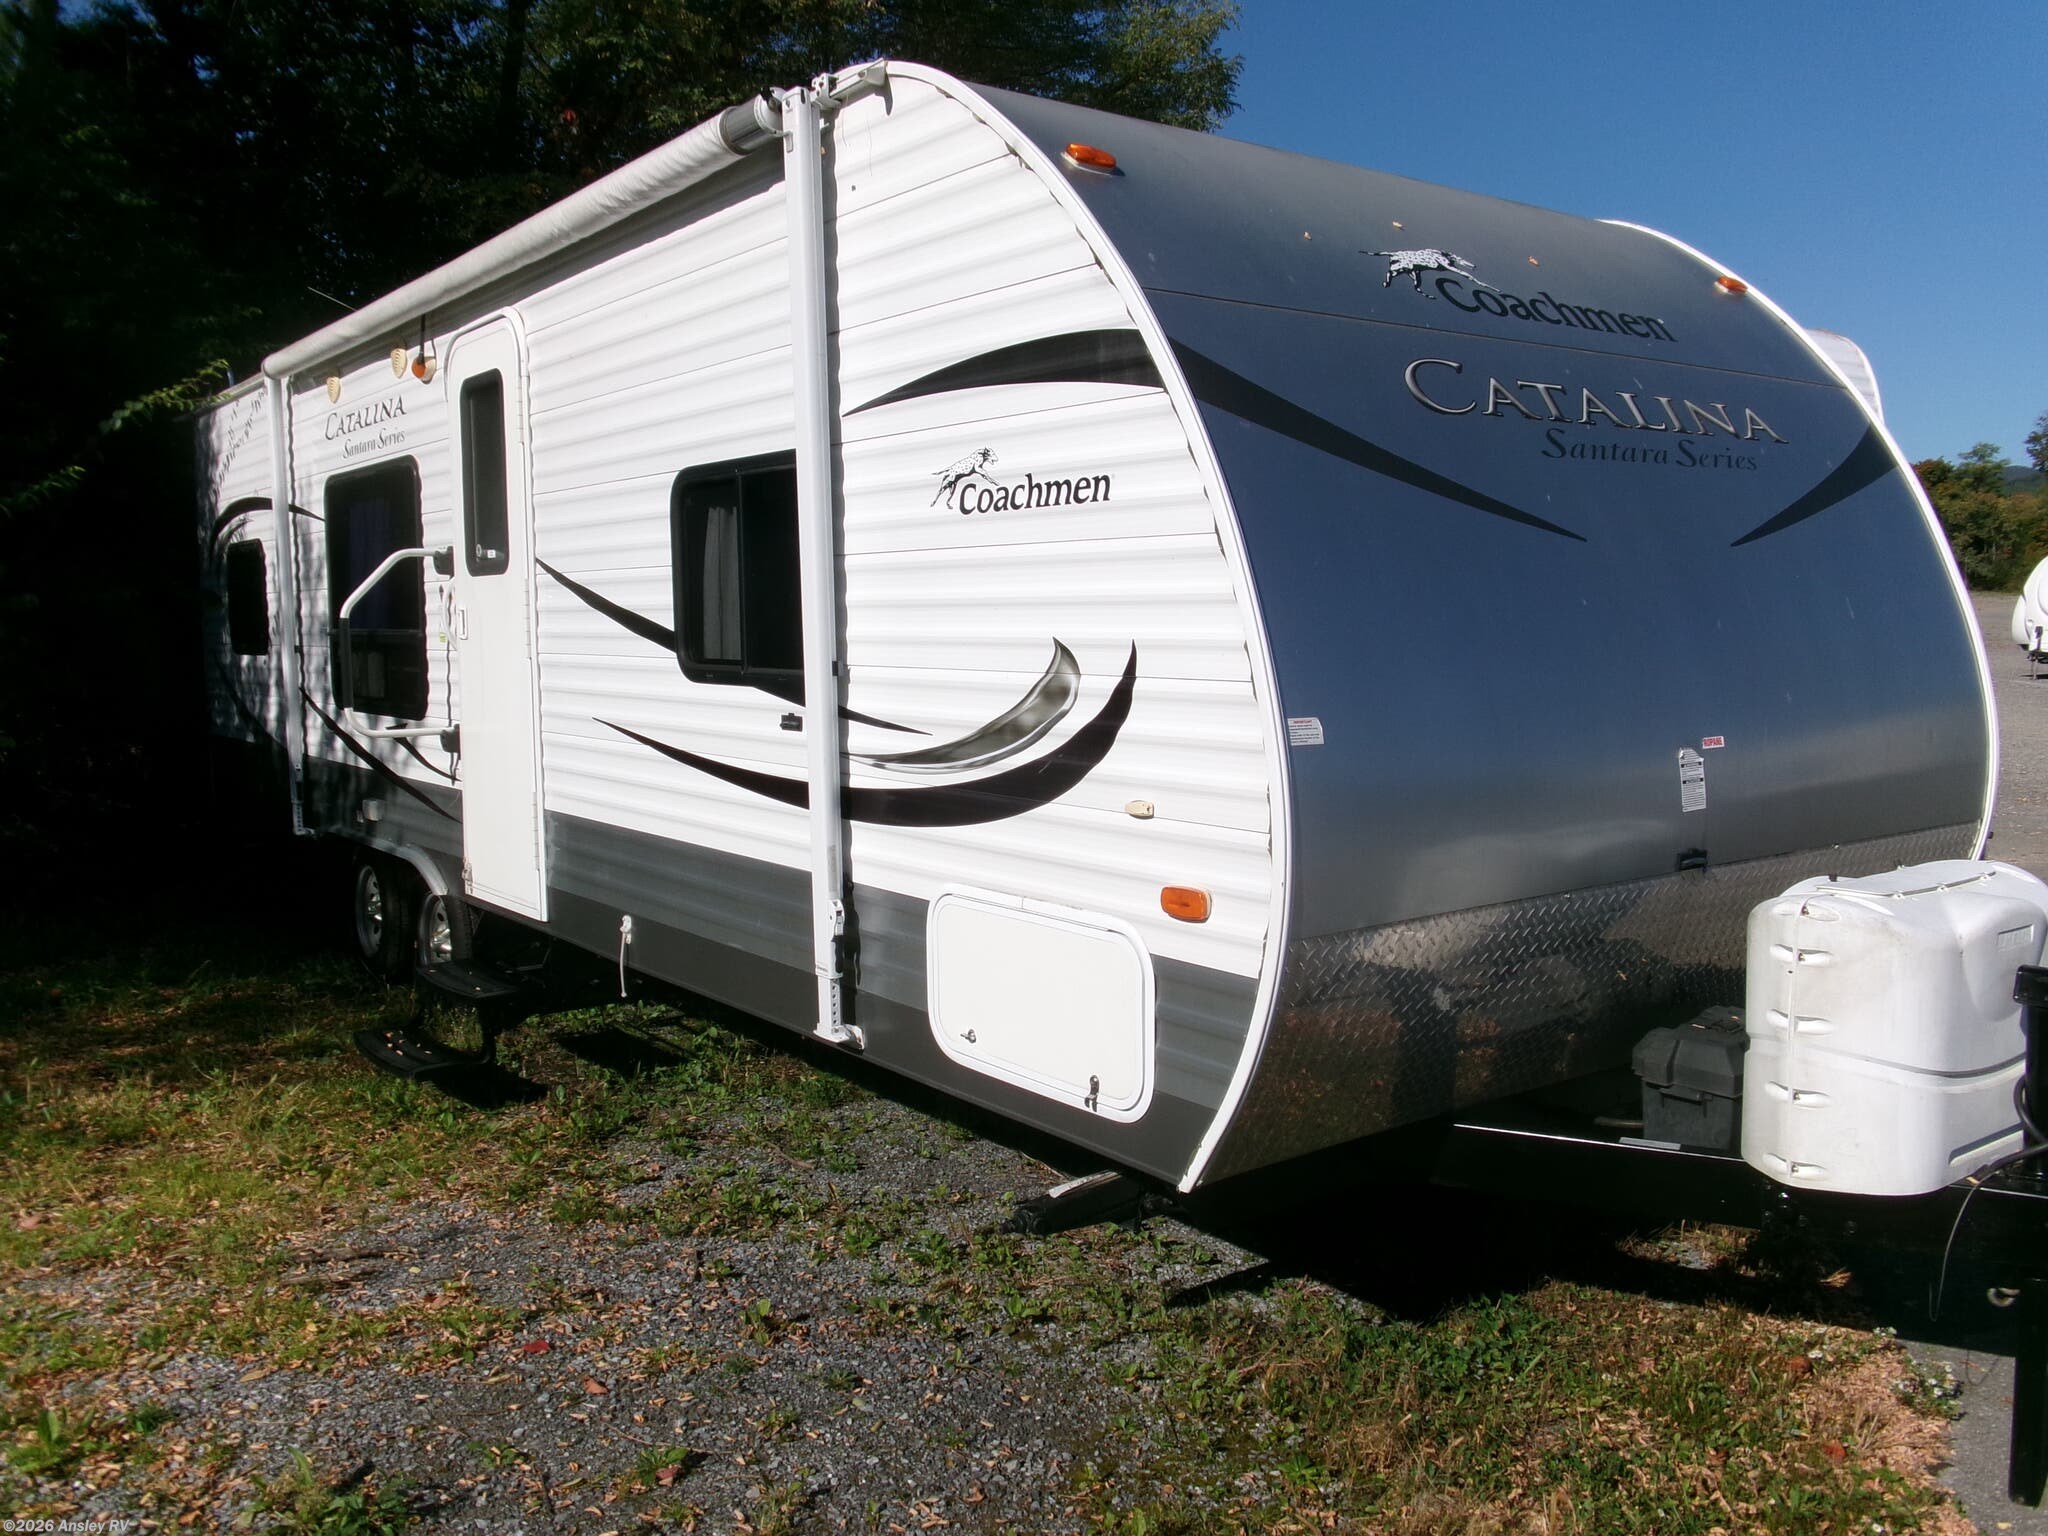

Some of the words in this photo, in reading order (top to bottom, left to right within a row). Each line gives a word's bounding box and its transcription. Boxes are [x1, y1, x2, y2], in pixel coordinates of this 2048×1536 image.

[1434, 276, 1678, 343] Coachmen
[325, 394, 407, 440] CATALINA
[1404, 357, 1790, 444] CATALINA
[343, 438, 376, 459] Santara
[377, 427, 405, 449] Series
[1541, 427, 1667, 465] Santara
[1675, 438, 1758, 471] Series
[959, 472, 1111, 516] Coachmen
